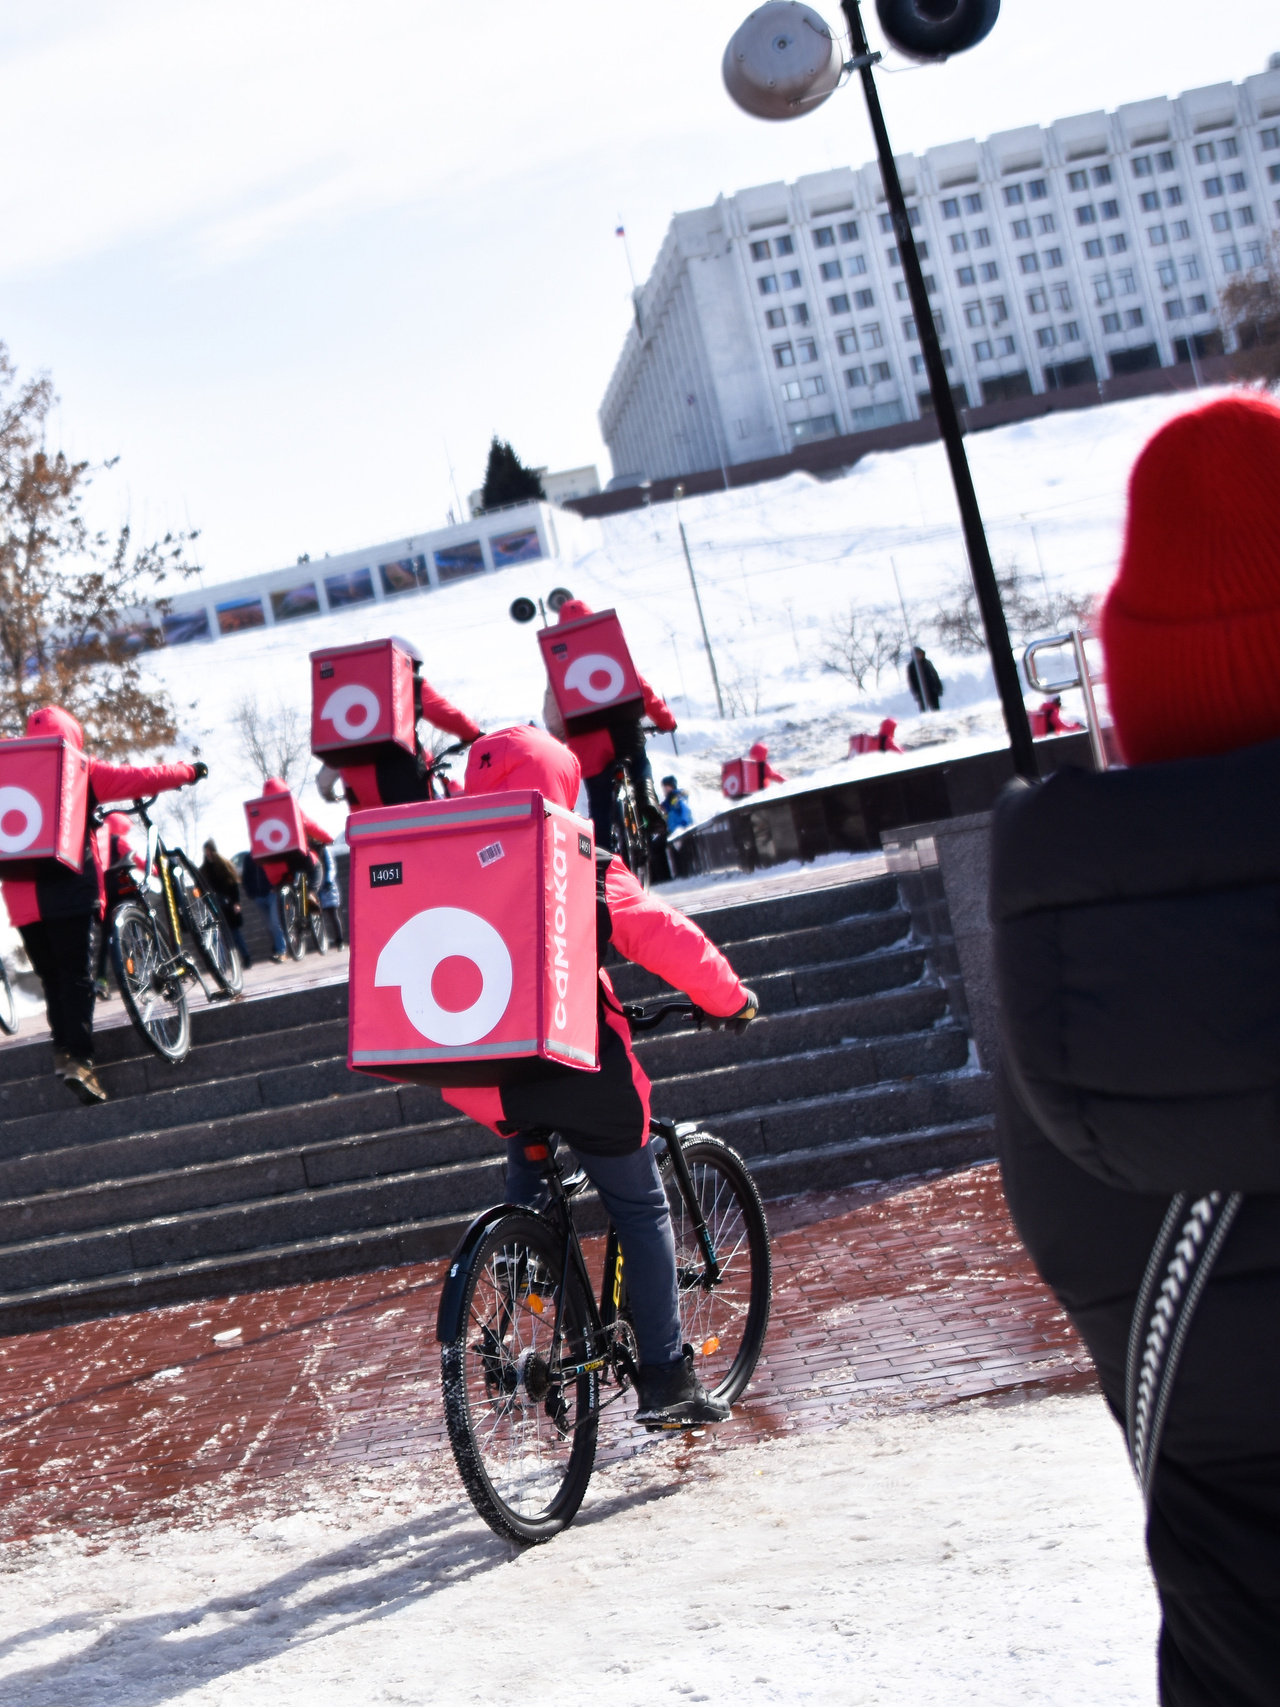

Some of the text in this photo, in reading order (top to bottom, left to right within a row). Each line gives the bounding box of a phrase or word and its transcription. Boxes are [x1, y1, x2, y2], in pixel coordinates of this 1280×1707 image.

[578, 838, 591, 854] 14051
[371, 868, 401, 882] 14051
[553, 821, 569, 1030] самокат
